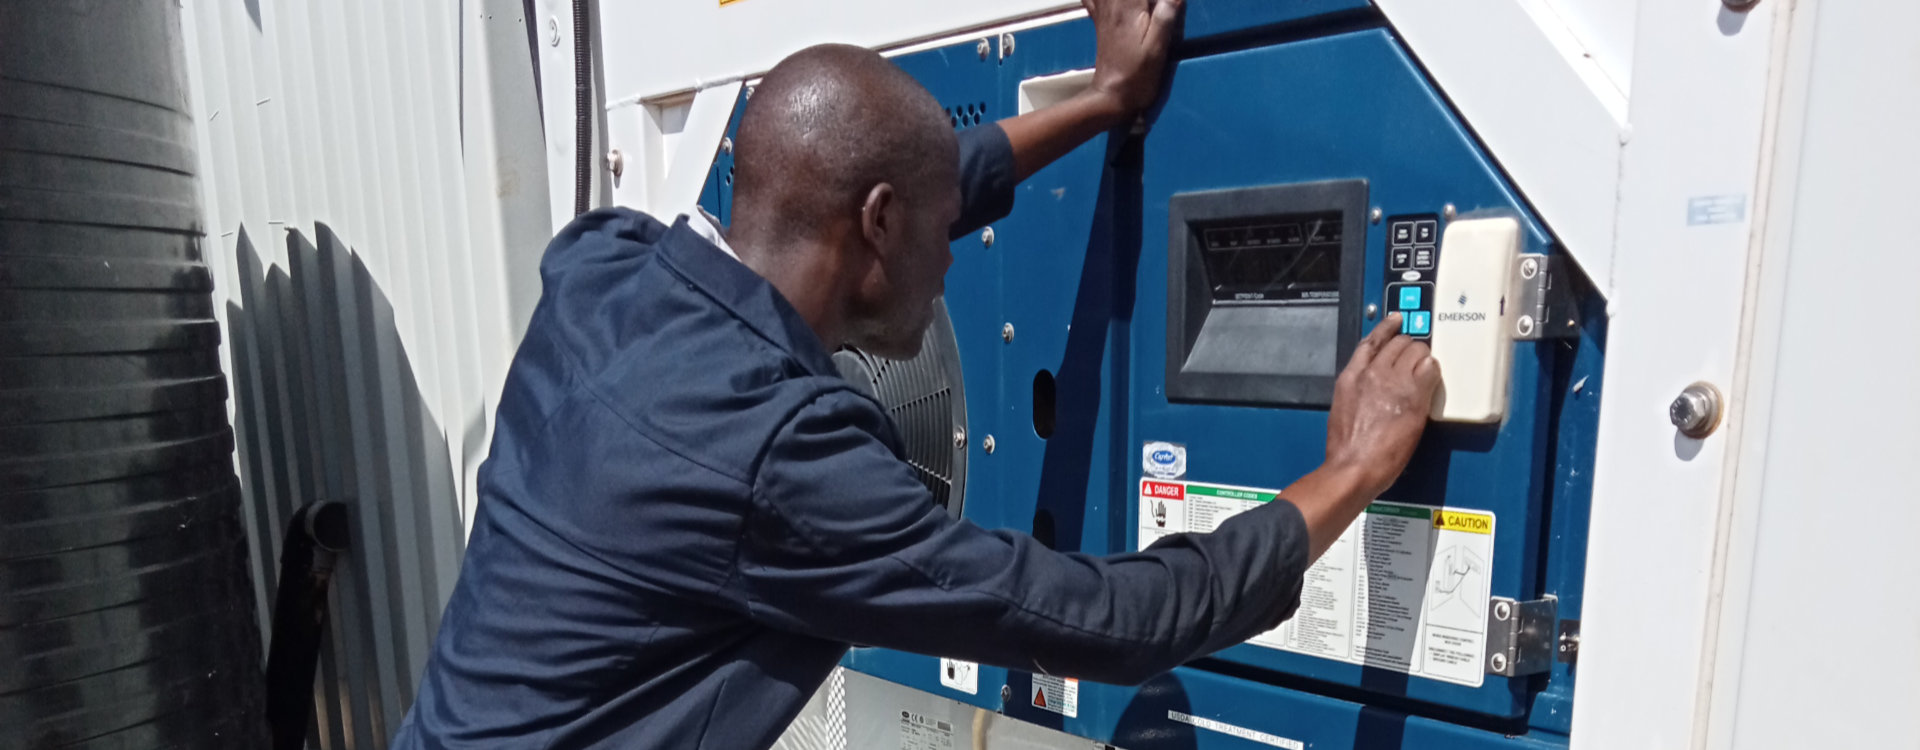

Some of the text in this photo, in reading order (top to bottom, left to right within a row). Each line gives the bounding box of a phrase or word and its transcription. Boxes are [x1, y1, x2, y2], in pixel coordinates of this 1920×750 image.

[1438, 312, 1486, 321] EMERSON
[1154, 485, 1179, 497] DANGER
[1216, 489, 1243, 498] CONTROLLER
[1448, 516, 1488, 530] CAUTION
[1171, 711, 1190, 723] USDA
[1215, 722, 1256, 739] TREATMENT
[1260, 733, 1299, 750] CERTIFIED
